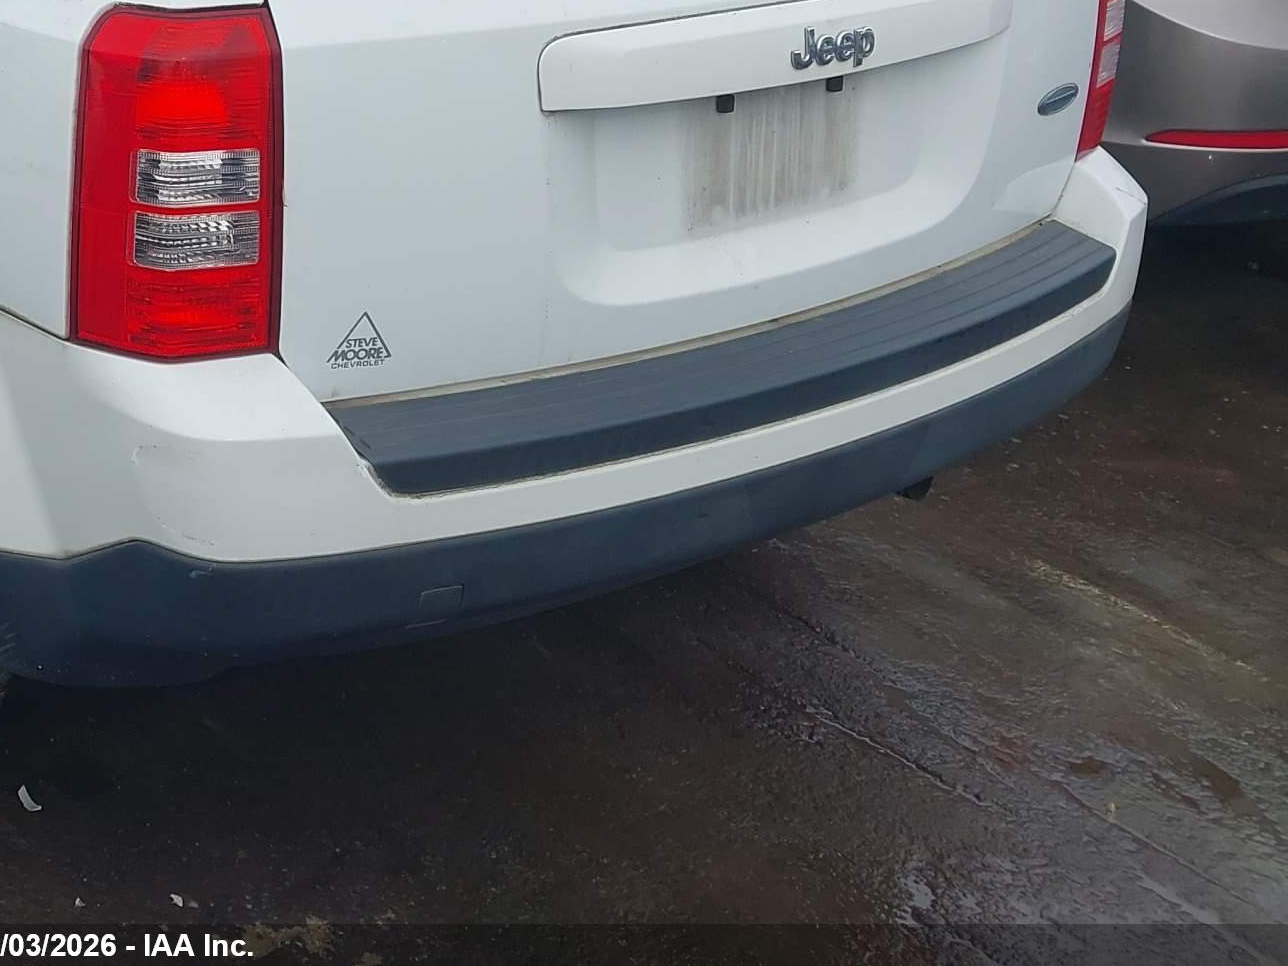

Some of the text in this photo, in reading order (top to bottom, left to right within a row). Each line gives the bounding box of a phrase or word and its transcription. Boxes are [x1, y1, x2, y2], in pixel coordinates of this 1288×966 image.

[790, 26, 875, 70] Jeep
[345, 337, 379, 349] STEVE
[326, 347, 384, 363] MOORE
[330, 359, 386, 370] CHEVROLET
